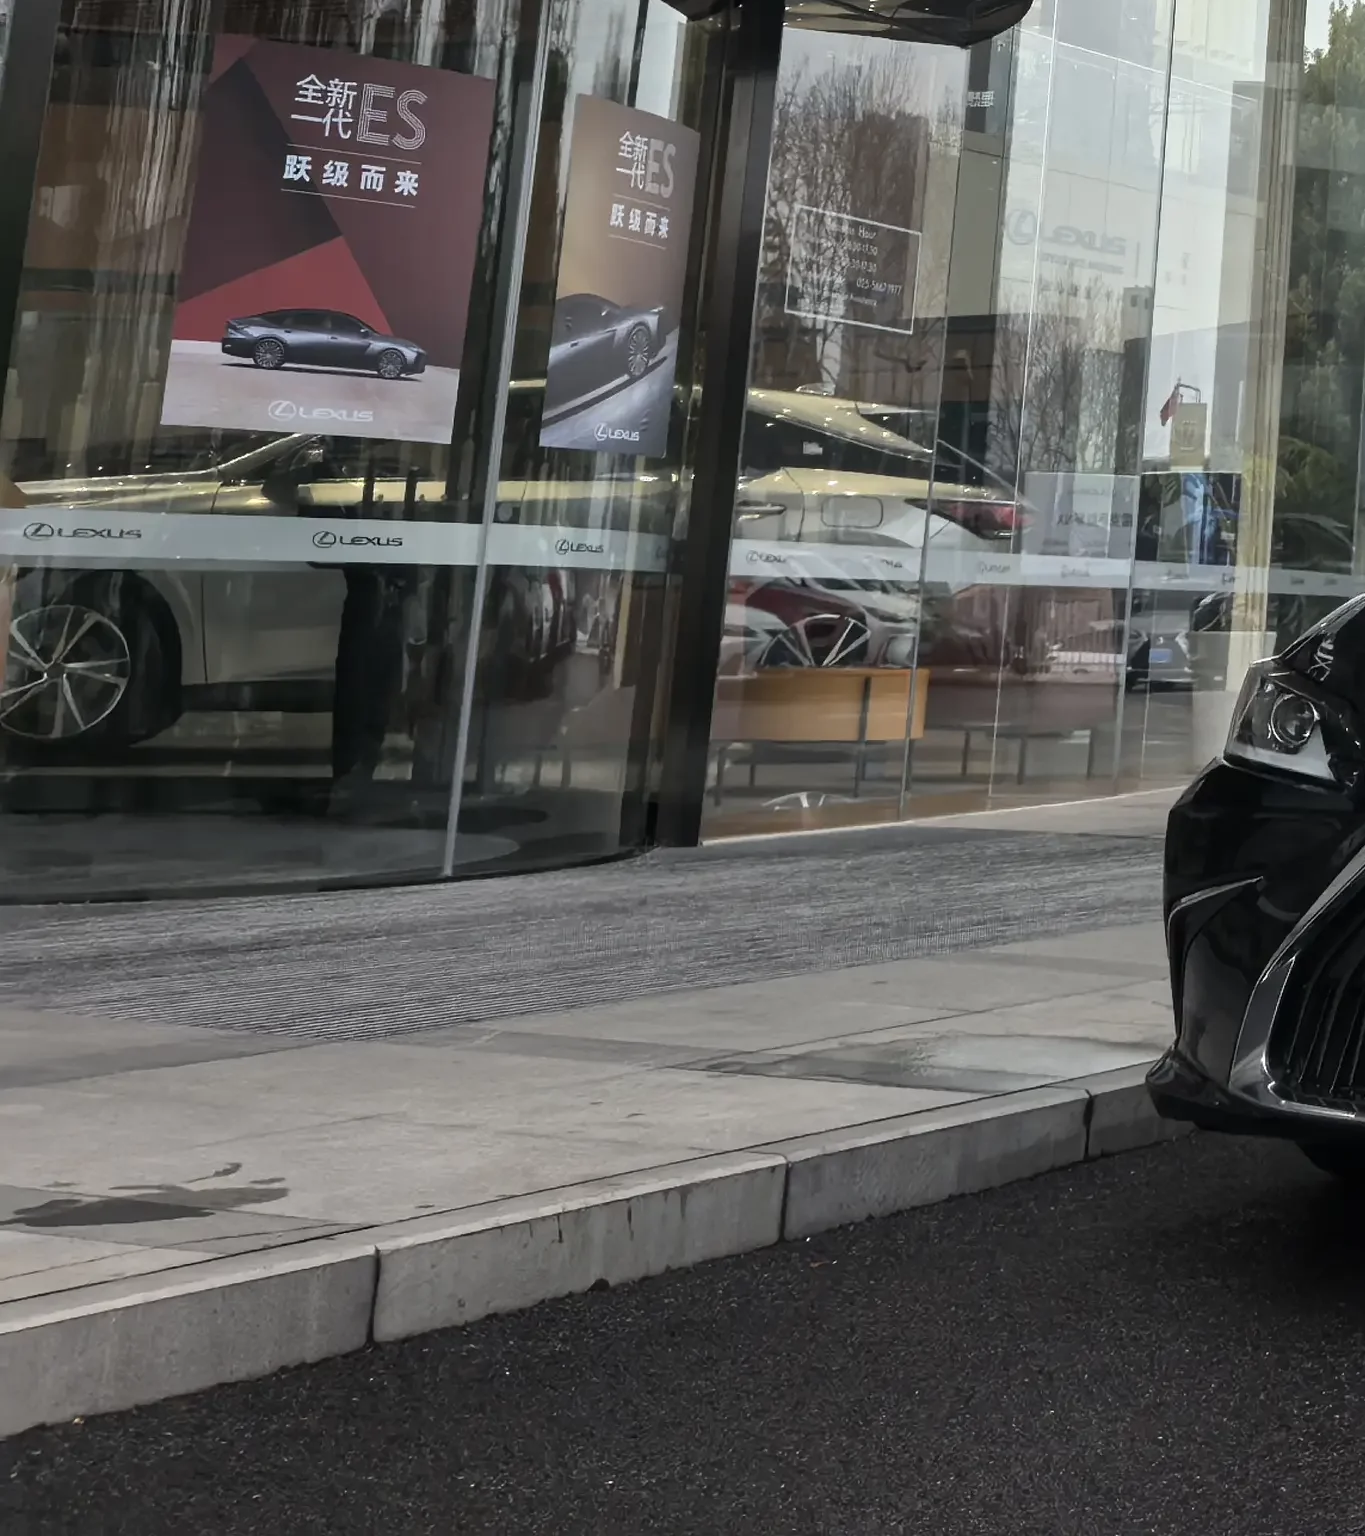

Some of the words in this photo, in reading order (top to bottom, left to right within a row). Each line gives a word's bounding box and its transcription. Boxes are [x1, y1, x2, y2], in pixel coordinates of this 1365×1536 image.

[294, 73, 358, 110] 全新
[290, 107, 355, 140] 一代
[356, 83, 428, 150] ES
[618, 130, 649, 163] 全新
[282, 154, 419, 197] 跃级而来
[615, 162, 646, 190] 一代
[645, 138, 677, 199] ES
[609, 203, 669, 239] 跃级而来
[299, 406, 374, 422] LEXUS
[608, 427, 640, 442] LEXUS
[57, 528, 142, 539] LEXUS
[339, 535, 403, 547] LEXUS
[570, 542, 604, 554] LEXUS
